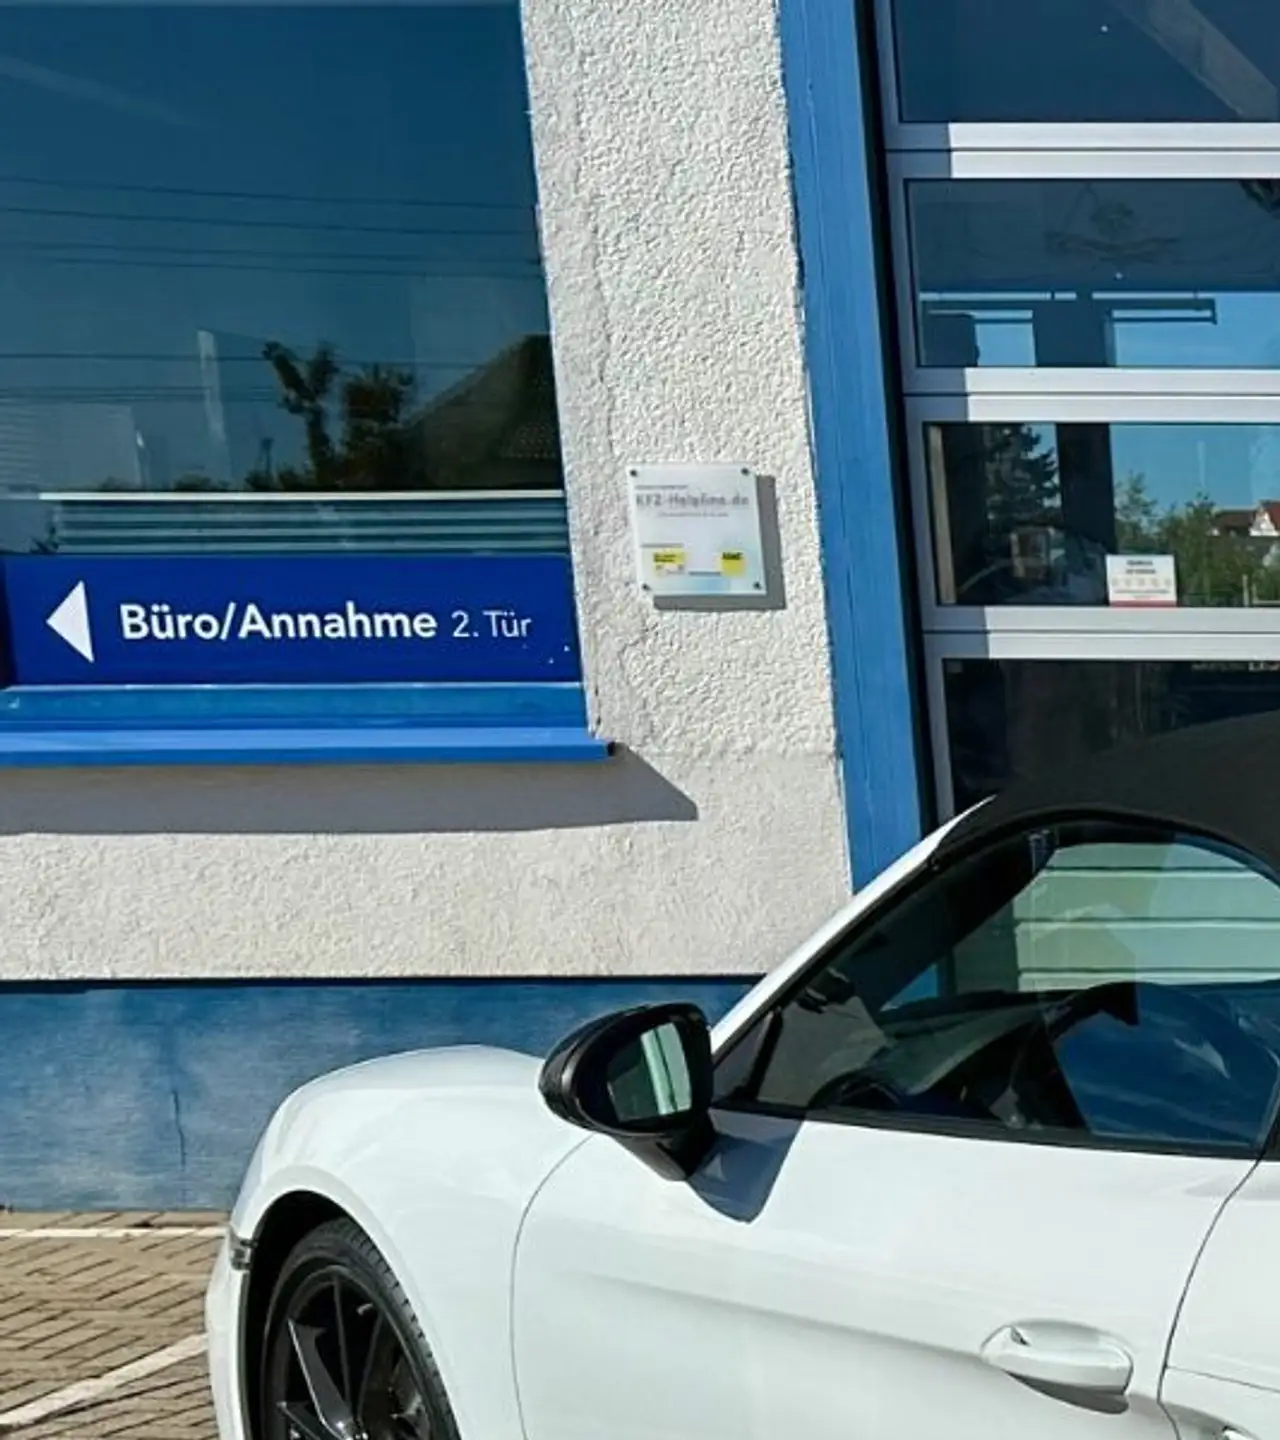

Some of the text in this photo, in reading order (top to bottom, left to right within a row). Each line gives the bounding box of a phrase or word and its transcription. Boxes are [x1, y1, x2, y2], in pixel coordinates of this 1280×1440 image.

[119, 600, 532, 642] Büro/Annahme 2. Tür
